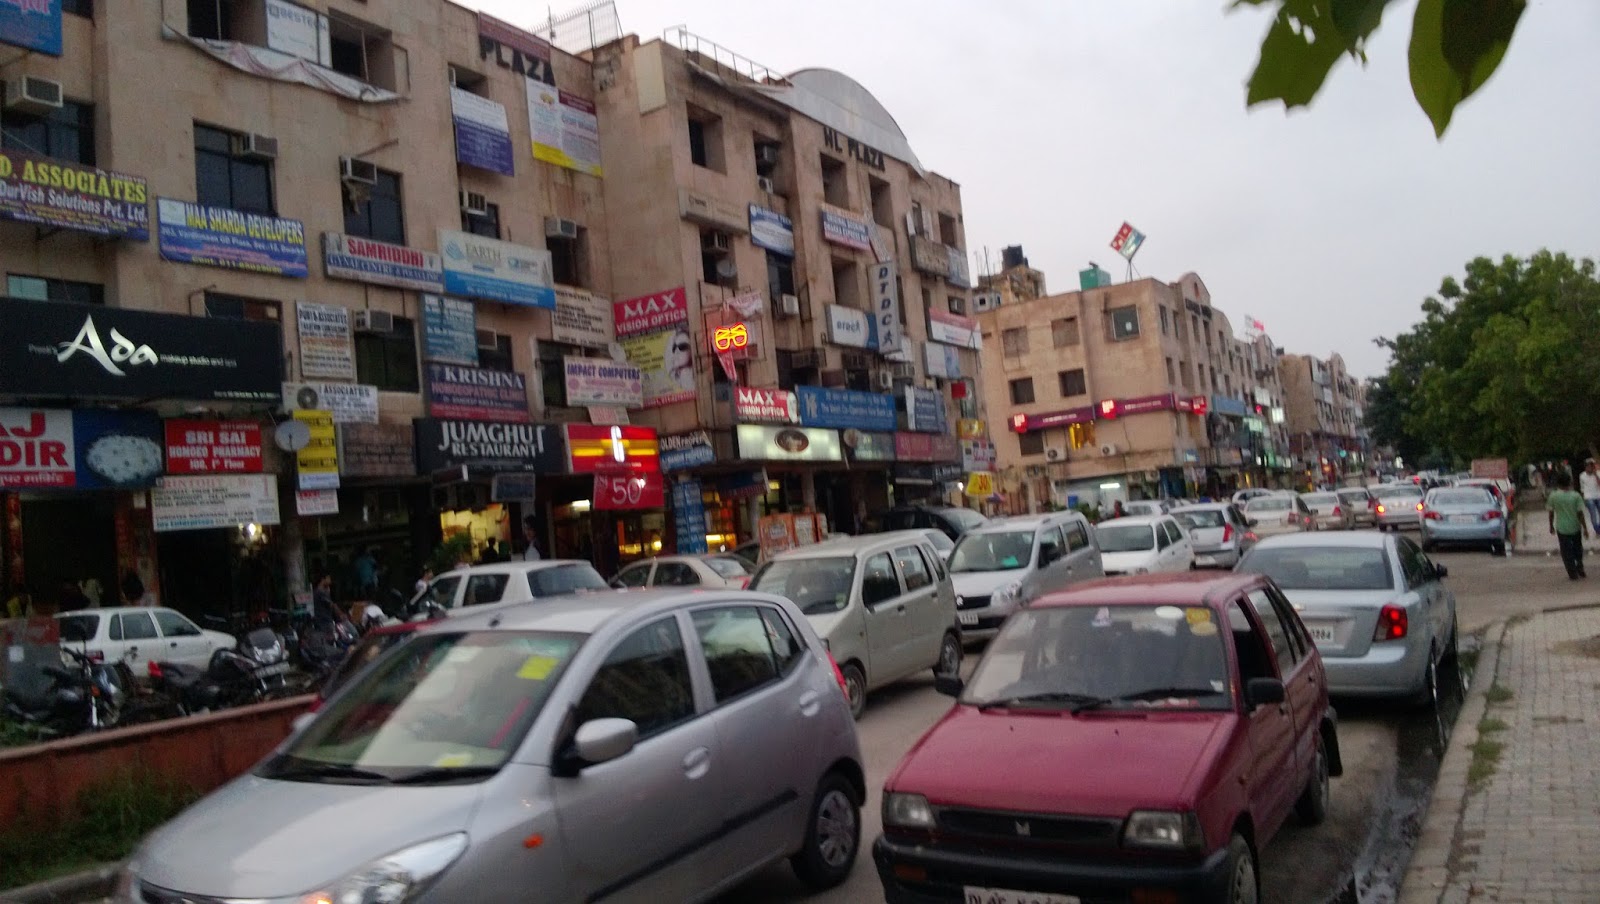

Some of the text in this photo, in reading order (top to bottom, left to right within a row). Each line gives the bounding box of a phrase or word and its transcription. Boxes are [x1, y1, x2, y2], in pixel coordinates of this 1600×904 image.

[479, 35, 556, 87] PLAZA
[847, 137, 886, 173] PLAZA
[22, 159, 148, 204] ASSOCIATES
[48, 188, 101, 214] Solutions
[185, 202, 304, 245] MAA SHARDA DEVELOPERS
[347, 238, 425, 268] SAMRIDDHI
[623, 290, 677, 319] MAX
[878, 266, 893, 328] DTDC
[616, 309, 687, 334] VISION OPTICS
[445, 366, 524, 391] KRISHNA
[567, 363, 641, 380] IMPACT COMPUTERS
[738, 388, 775, 405] MAX
[737, 405, 785, 417] VISION OPTICS
[185, 430, 247, 445] SRI SAI
[438, 420, 546, 454] JUMGHUT
[451, 442, 536, 458] RESTAURANT
[212, 445, 262, 458] PHARMACY
